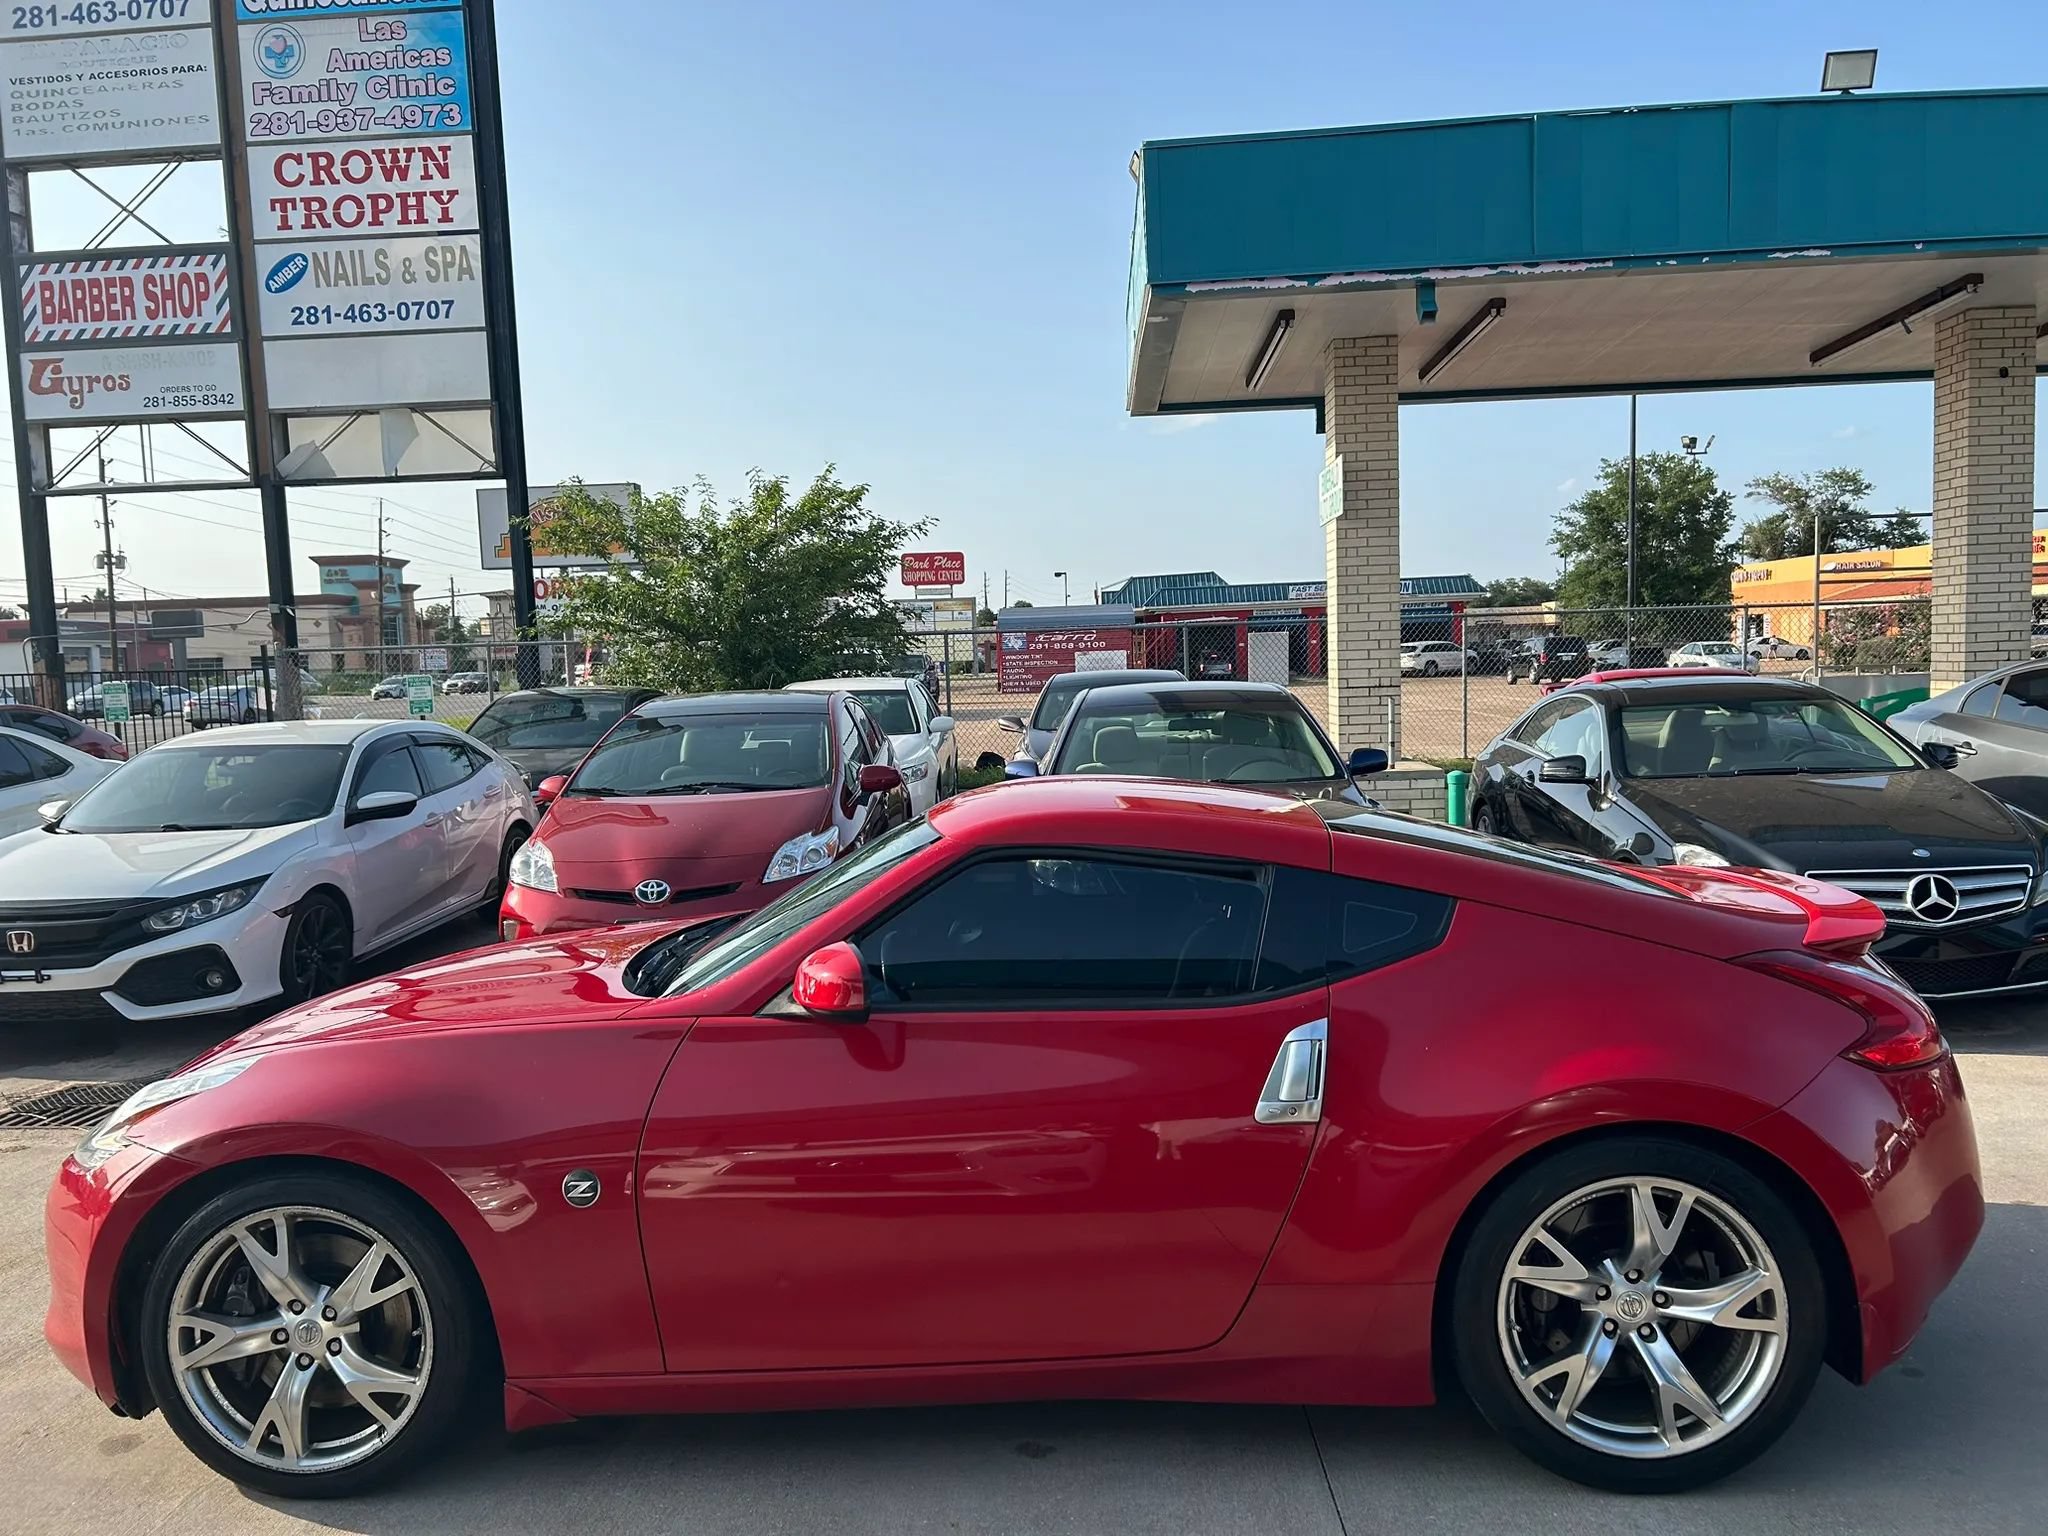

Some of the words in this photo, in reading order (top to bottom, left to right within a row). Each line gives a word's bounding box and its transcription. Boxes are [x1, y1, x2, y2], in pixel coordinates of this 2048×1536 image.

[12, 0, 191, 29] 281-463-0707
[358, 18, 407, 42] Las
[327, 45, 452, 72] Americas
[10, 74, 72, 85] VESTIDOS
[76, 73, 84, 81] Y
[89, 66, 168, 80] ACCESORIOS
[171, 64, 207, 74] PARA:
[253, 77, 357, 106] Family
[365, 73, 456, 100] Clinic
[11, 99, 84, 112] BODAS
[12, 109, 121, 124] BAUTIZOS
[62, 115, 210, 132] COMUNIONES
[250, 103, 461, 136] 281-937-4973
[273, 145, 451, 188] CROWN
[270, 190, 459, 231] TROPHY
[268, 255, 307, 292] AMBER
[311, 247, 392, 288] NAILS
[401, 256, 417, 284] &
[424, 244, 475, 283] SPA
[39, 275, 136, 325] BARBER
[143, 272, 210, 320] SHOP
[291, 300, 454, 326] 281-463-0707
[28, 357, 131, 409] Gyros
[160, 386, 191, 394] ORDERS
[205, 384, 217, 392] GO
[143, 393, 234, 408] 281-855-8342
[904, 556, 930, 569] Park
[1836, 562, 1854, 570] HAIR
[1856, 560, 1881, 569] SALON
[903, 570, 935, 582] SHOPPING
[937, 570, 963, 581] CENTER
[566, 1180, 595, 1198] Z
